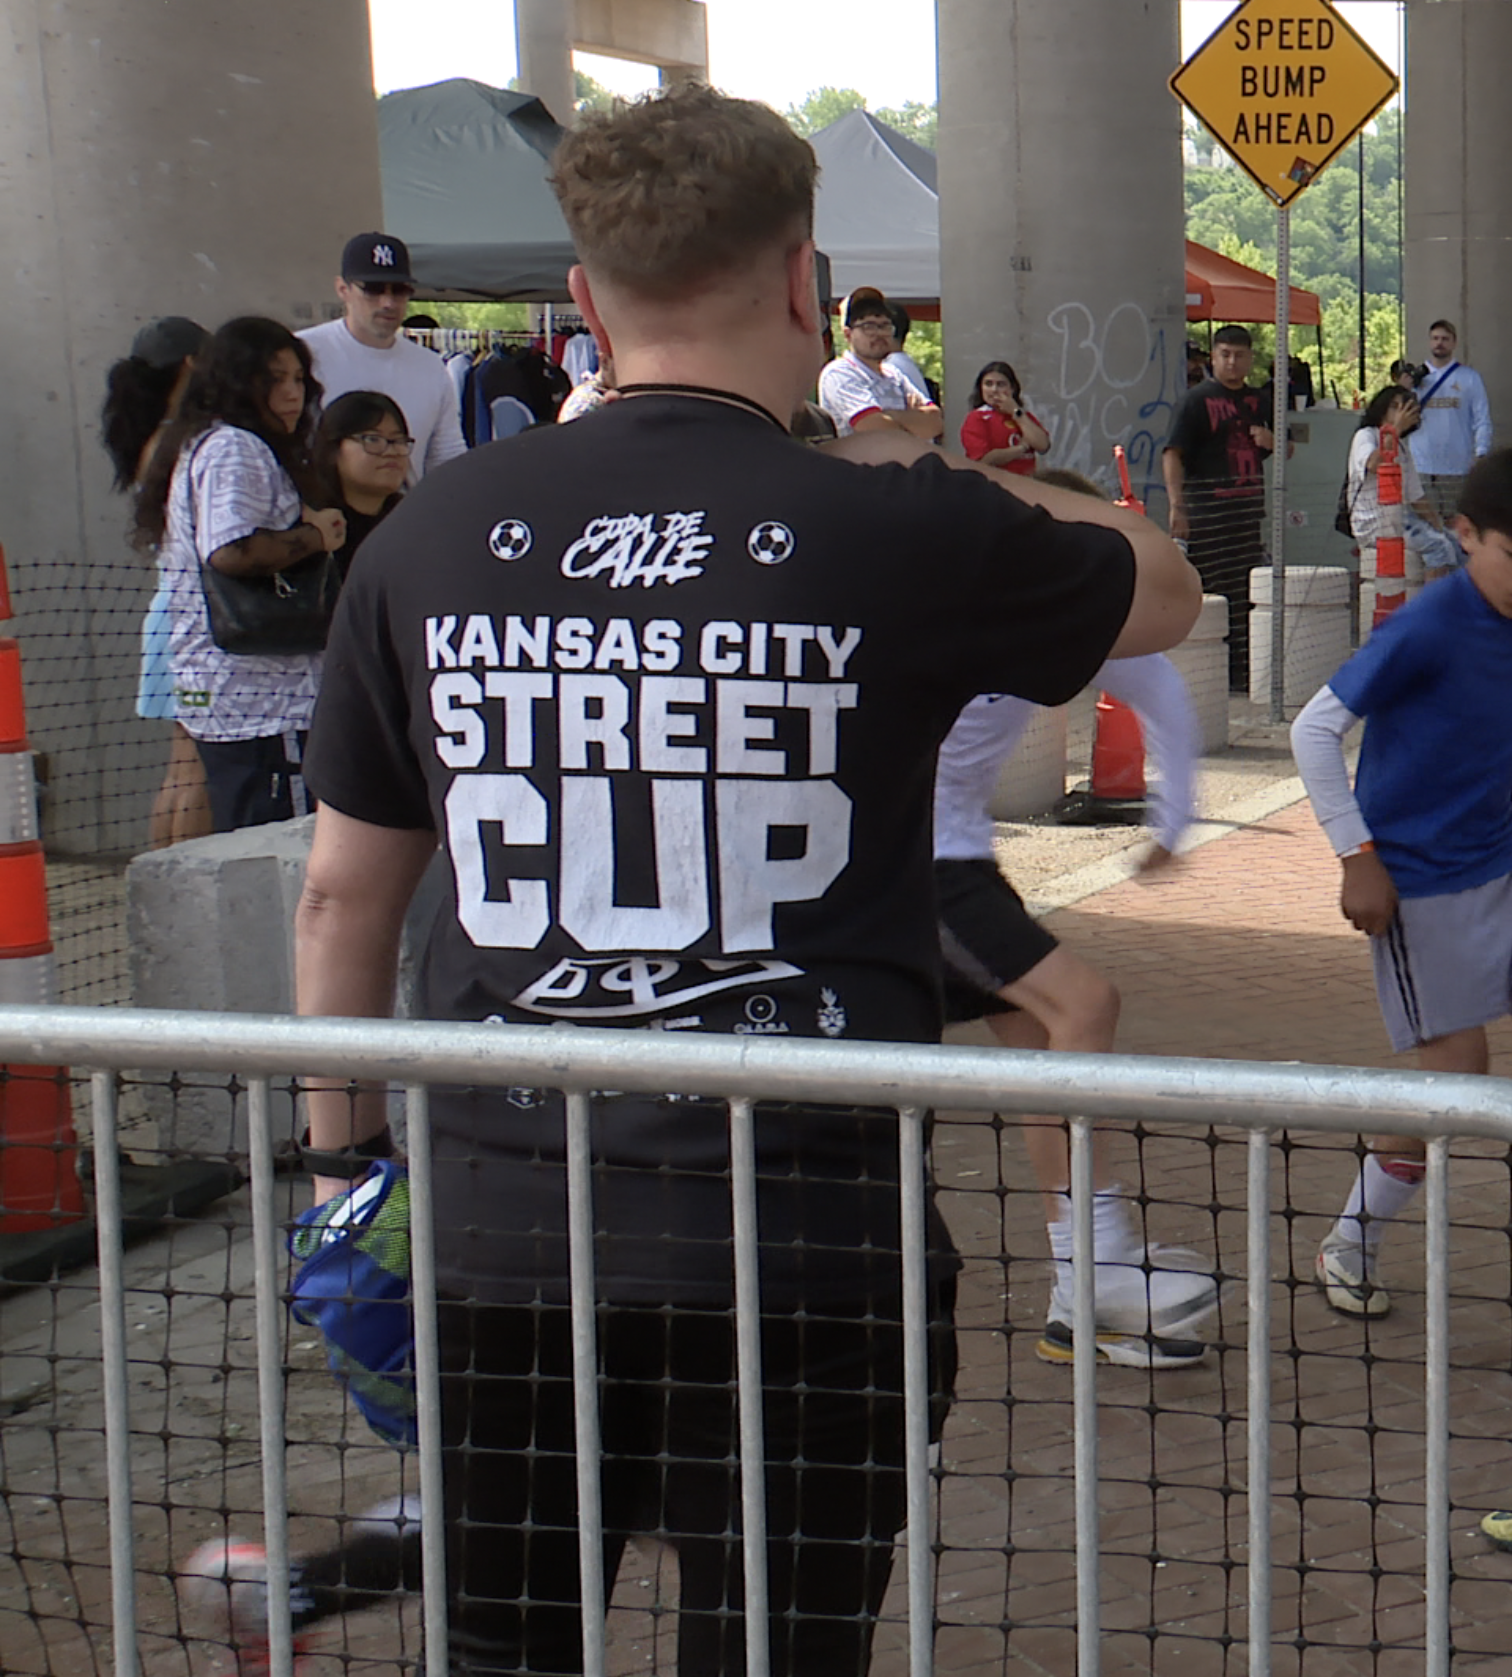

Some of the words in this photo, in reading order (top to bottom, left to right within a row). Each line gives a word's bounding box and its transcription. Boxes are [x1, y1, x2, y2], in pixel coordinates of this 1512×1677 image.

[1234, 18, 1334, 51] SPEED
[1241, 65, 1326, 98] BUMP
[1233, 112, 1334, 145] AHEAD
[373, 244, 394, 266] NY
[583, 512, 655, 550] COPA
[660, 510, 706, 539] DE
[560, 532, 714, 589] CALLE
[424, 614, 682, 672] KANSAS
[701, 620, 862, 678] CITY
[429, 671, 859, 776] STREET
[444, 773, 853, 954] CUP
